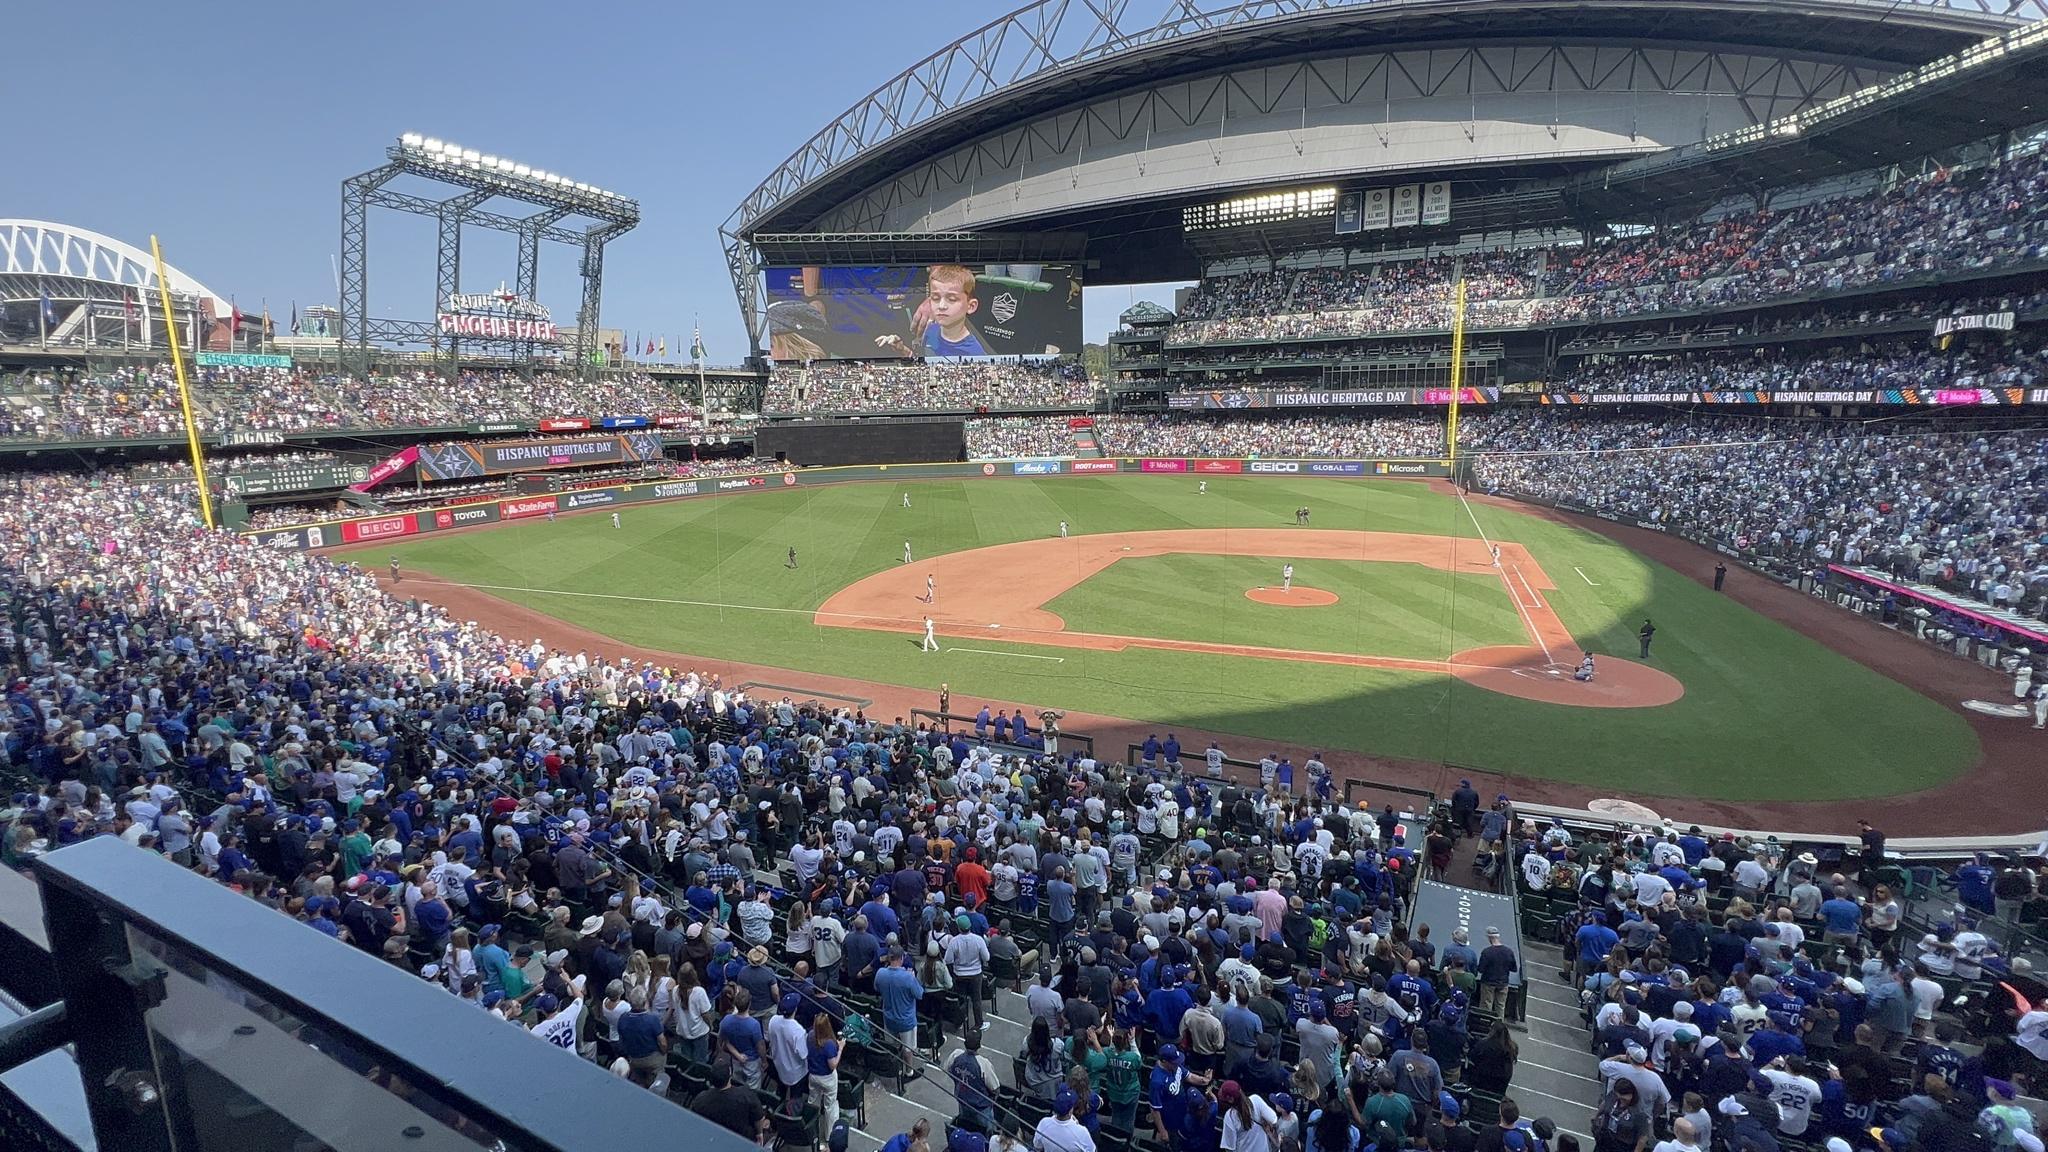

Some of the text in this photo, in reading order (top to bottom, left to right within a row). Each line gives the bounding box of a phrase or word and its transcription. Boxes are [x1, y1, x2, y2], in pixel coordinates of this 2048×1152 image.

[1365, 218, 1388, 226] CHAMPIONS
[1393, 215, 1417, 223] CHAMPIONS
[450, 293, 493, 311] SEATTLE
[1985, 311, 2015, 330] CLUB
[516, 319, 560, 339] PARK
[205, 354, 282, 366] ELECTRIC FACTORY
[1276, 391, 1407, 405] HISPANIC HERITAGE DAY
[1438, 391, 1468, 401] Moile
[1593, 393, 1688, 403] HISPANIC HERITAGE DAY
[1775, 392, 1873, 402] HISPANIC HERITAGE DAY
[1949, 392, 1976, 401] Mobile
[496, 442, 612, 461] HISPANIC HERITAGE DAY
[1251, 462, 1299, 473] GEICO
[1313, 464, 1344, 472] GLOBAL
[1388, 464, 1425, 474] Microsoft
[720, 479, 750, 489] KeyBank
[662, 486, 698, 497] FOUNDATION
[454, 510, 488, 521] TOYOTA
[1166, 809, 1178, 817] 40
[836, 832, 848, 842] 24
[883, 839, 892, 850] 11
[1304, 855, 1319, 866] 34
[1529, 865, 1541, 875] 10
[1980, 875, 1989, 885] 3
[1020, 884, 1034, 897] 22
[814, 928, 832, 941] 32
[1359, 943, 1370, 954] 11
[1402, 981, 1420, 991] BETTS
[1293, 1001, 1310, 1014] 50
[1782, 1003, 1802, 1011] BETTS
[1363, 1007, 1377, 1021] 21
[544, 1021, 570, 1038] KOUFAX
[549, 1028, 574, 1049] 32
[1939, 1066, 1958, 1084] 34
[1781, 1092, 1806, 1110] 22
[1842, 1103, 1869, 1120] 50
